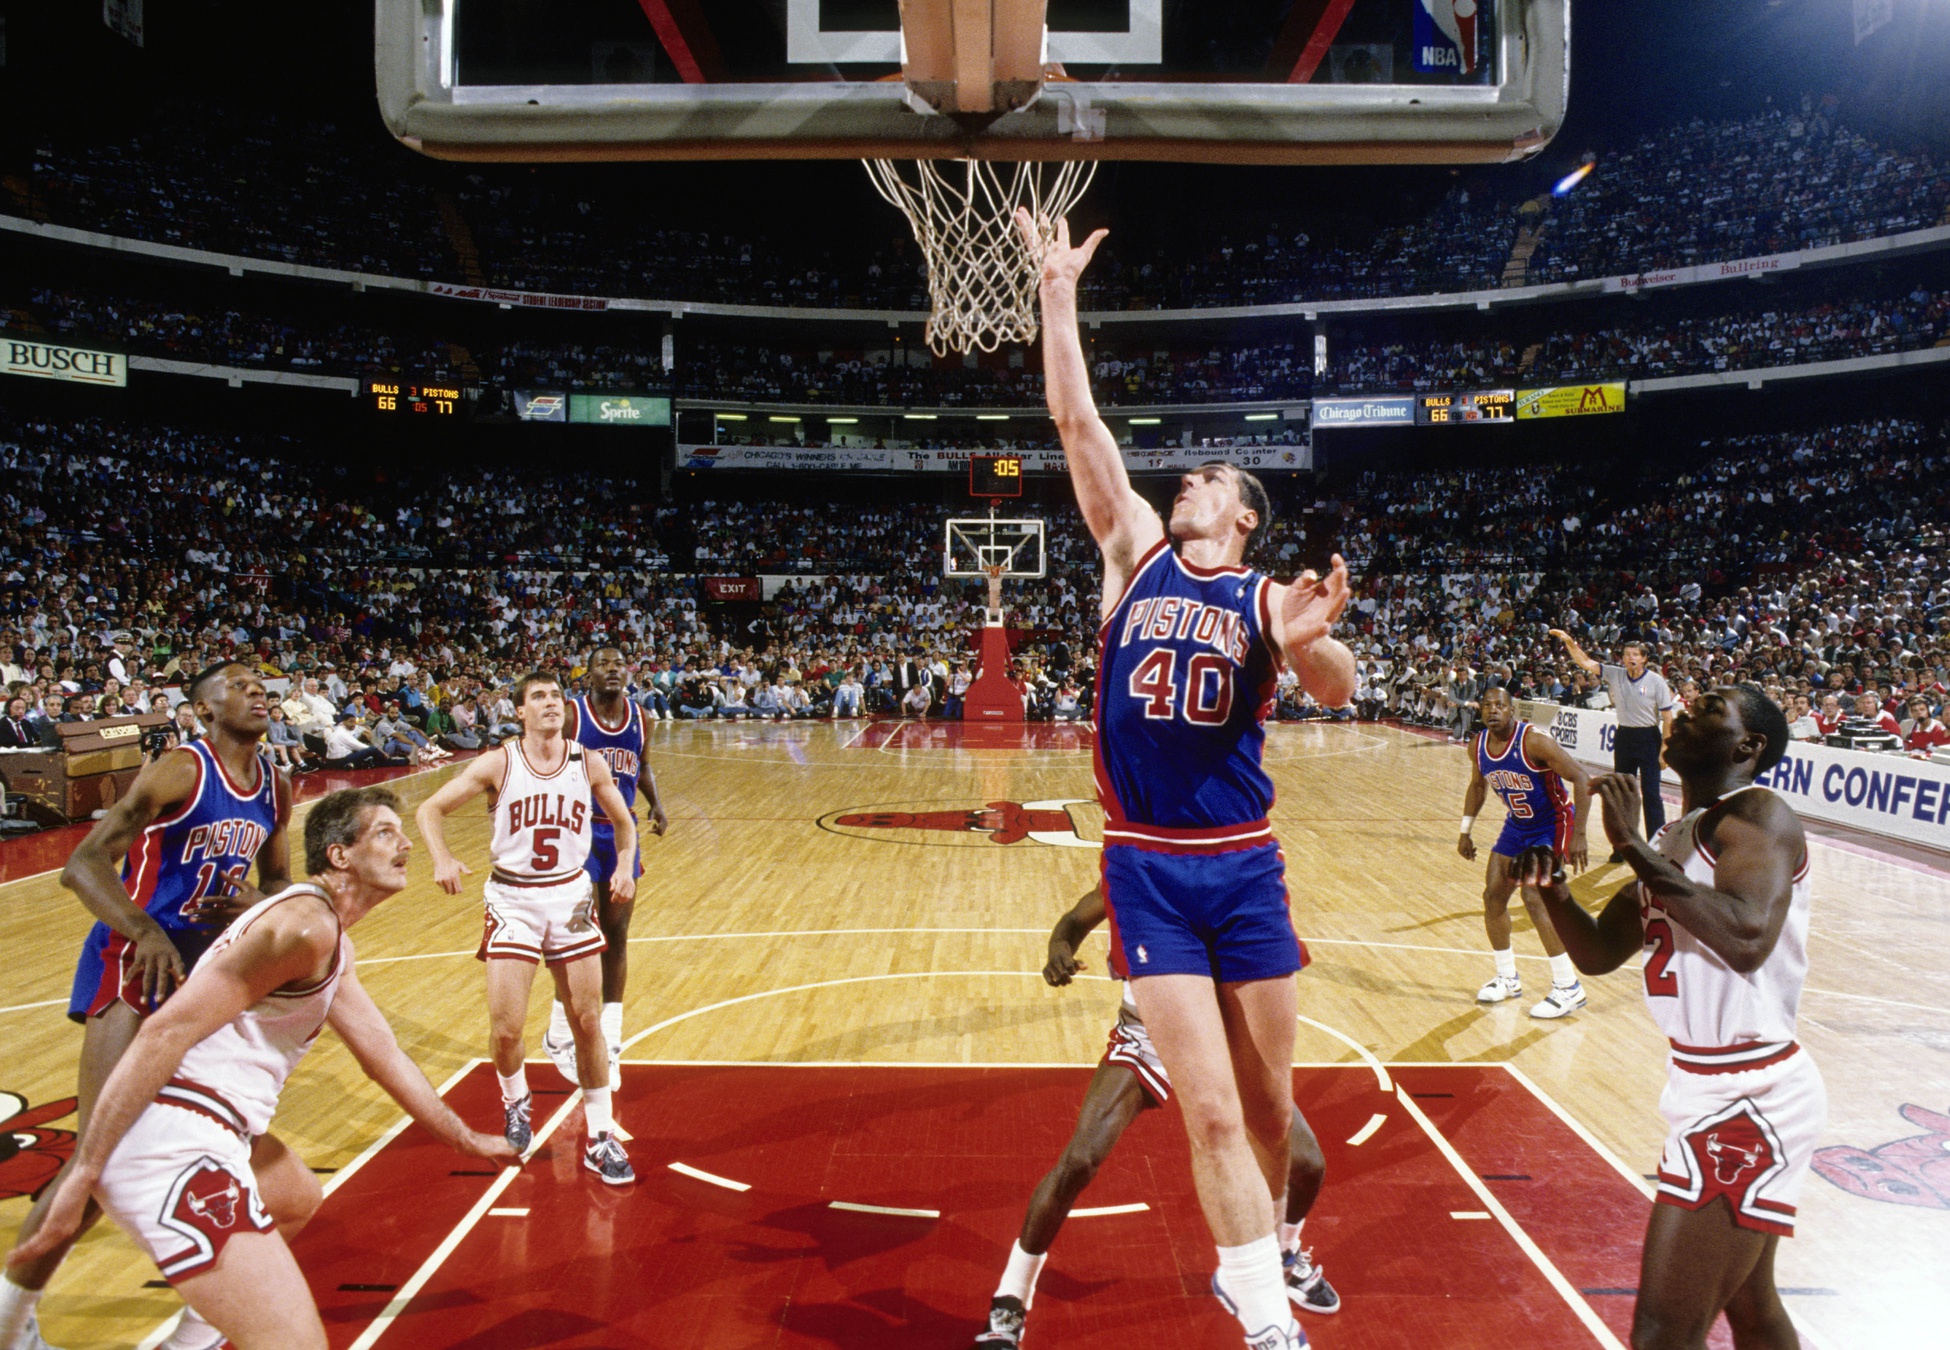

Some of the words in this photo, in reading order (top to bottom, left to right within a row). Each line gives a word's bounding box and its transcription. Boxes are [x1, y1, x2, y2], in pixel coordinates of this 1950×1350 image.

[1422, 46, 1457, 66] NBA
[1620, 272, 1676, 288] Budweiser
[1721, 258, 1780, 275] Bullring
[523, 295, 547, 306] STUDENT
[548, 296, 582, 308] LEADERSHIP
[8, 342, 115, 376] BUSCH
[372, 384, 399, 394] BULLS
[423, 387, 459, 399] PISTONS
[378, 396, 396, 410] 66
[435, 400, 453, 414] 77
[1425, 397, 1451, 407] BULLS
[1474, 394, 1510, 405] PISTONS
[600, 402, 640, 422] Sprite
[1319, 405, 1362, 420] Chicago
[1363, 404, 1407, 418] Tribune
[1431, 408, 1448, 422] 66
[1486, 406, 1504, 419] 77
[1565, 405, 1622, 415] SUBMARINE
[744, 451, 792, 460] CHICAGO'S
[796, 453, 836, 461] WINNERS
[907, 452, 930, 460] The
[937, 452, 977, 460] BULLS
[1039, 452, 1065, 460] Line
[1184, 448, 1231, 456] Rebound
[994, 459, 1019, 476] :05
[1243, 456, 1261, 466] 30
[720, 584, 746, 593] EXIT
[1120, 596, 1250, 668] PISTONS
[1129, 647, 1234, 726] 40
[1563, 711, 1578, 728] CBS
[1550, 726, 1578, 745] SPORTS
[509, 793, 586, 836] BULLS
[531, 828, 561, 871] 5
